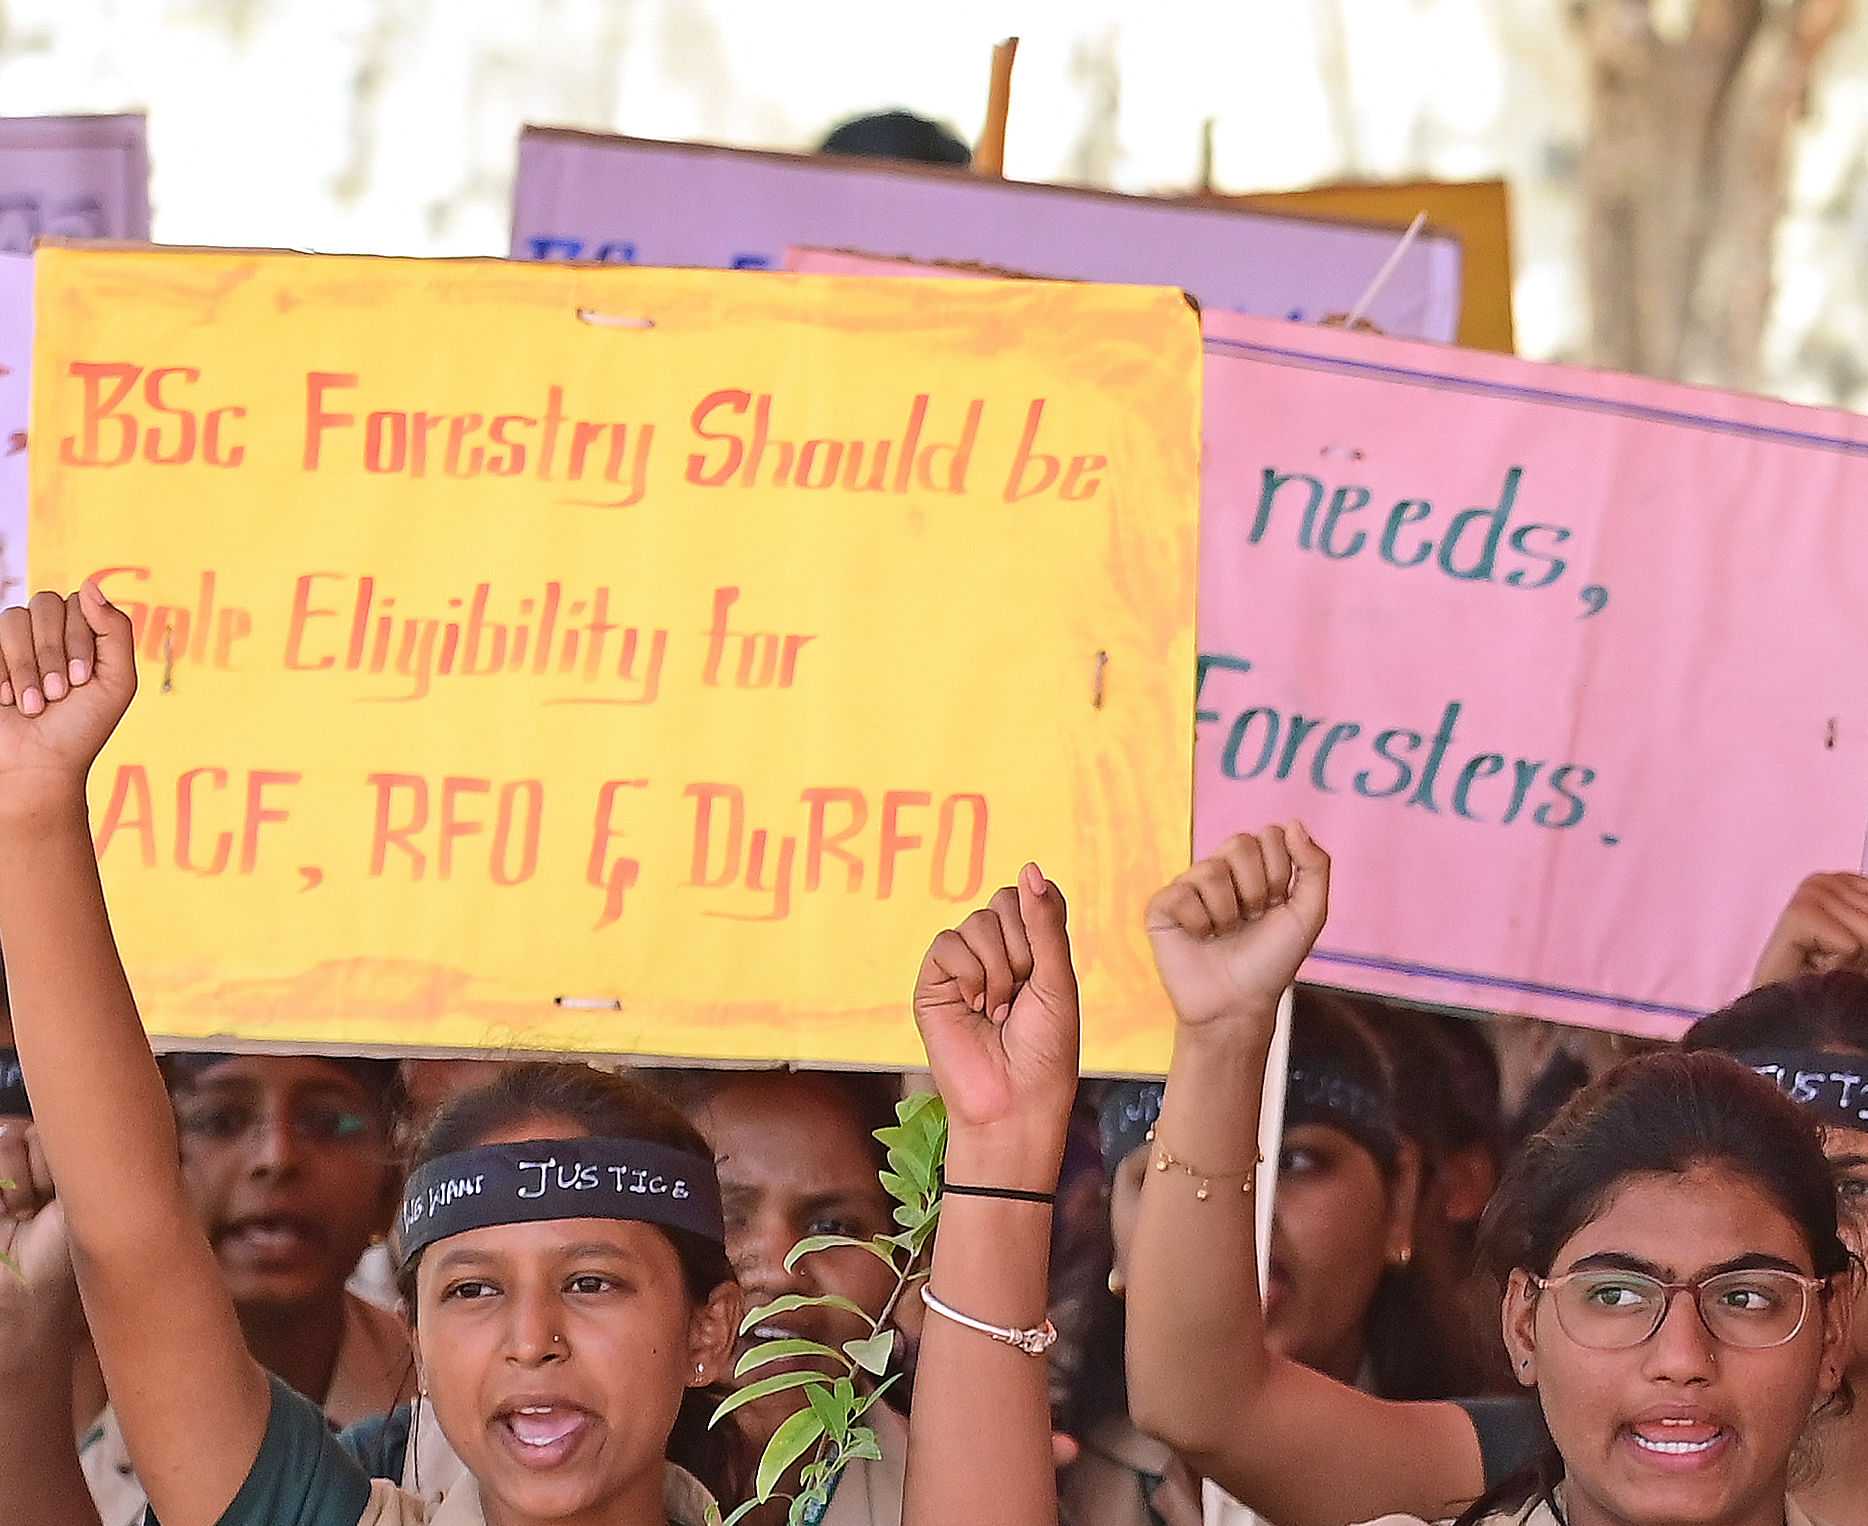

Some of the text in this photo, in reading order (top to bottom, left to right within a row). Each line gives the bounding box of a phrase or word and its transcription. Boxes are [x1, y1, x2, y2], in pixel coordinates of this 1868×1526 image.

[58, 361, 1108, 508] BSc Forestry Should be
[1249, 465, 1611, 621] needs,
[283, 571, 670, 705] Eligibility
[700, 585, 820, 692] for
[1195, 653, 1621, 848] Foresters.
[92, 762, 324, 895] ACF,
[362, 768, 544, 890] RFO
[681, 780, 990, 923] DyRFO
[427, 1173, 486, 1218] WANT
[516, 1156, 690, 1200] JUSTICE
